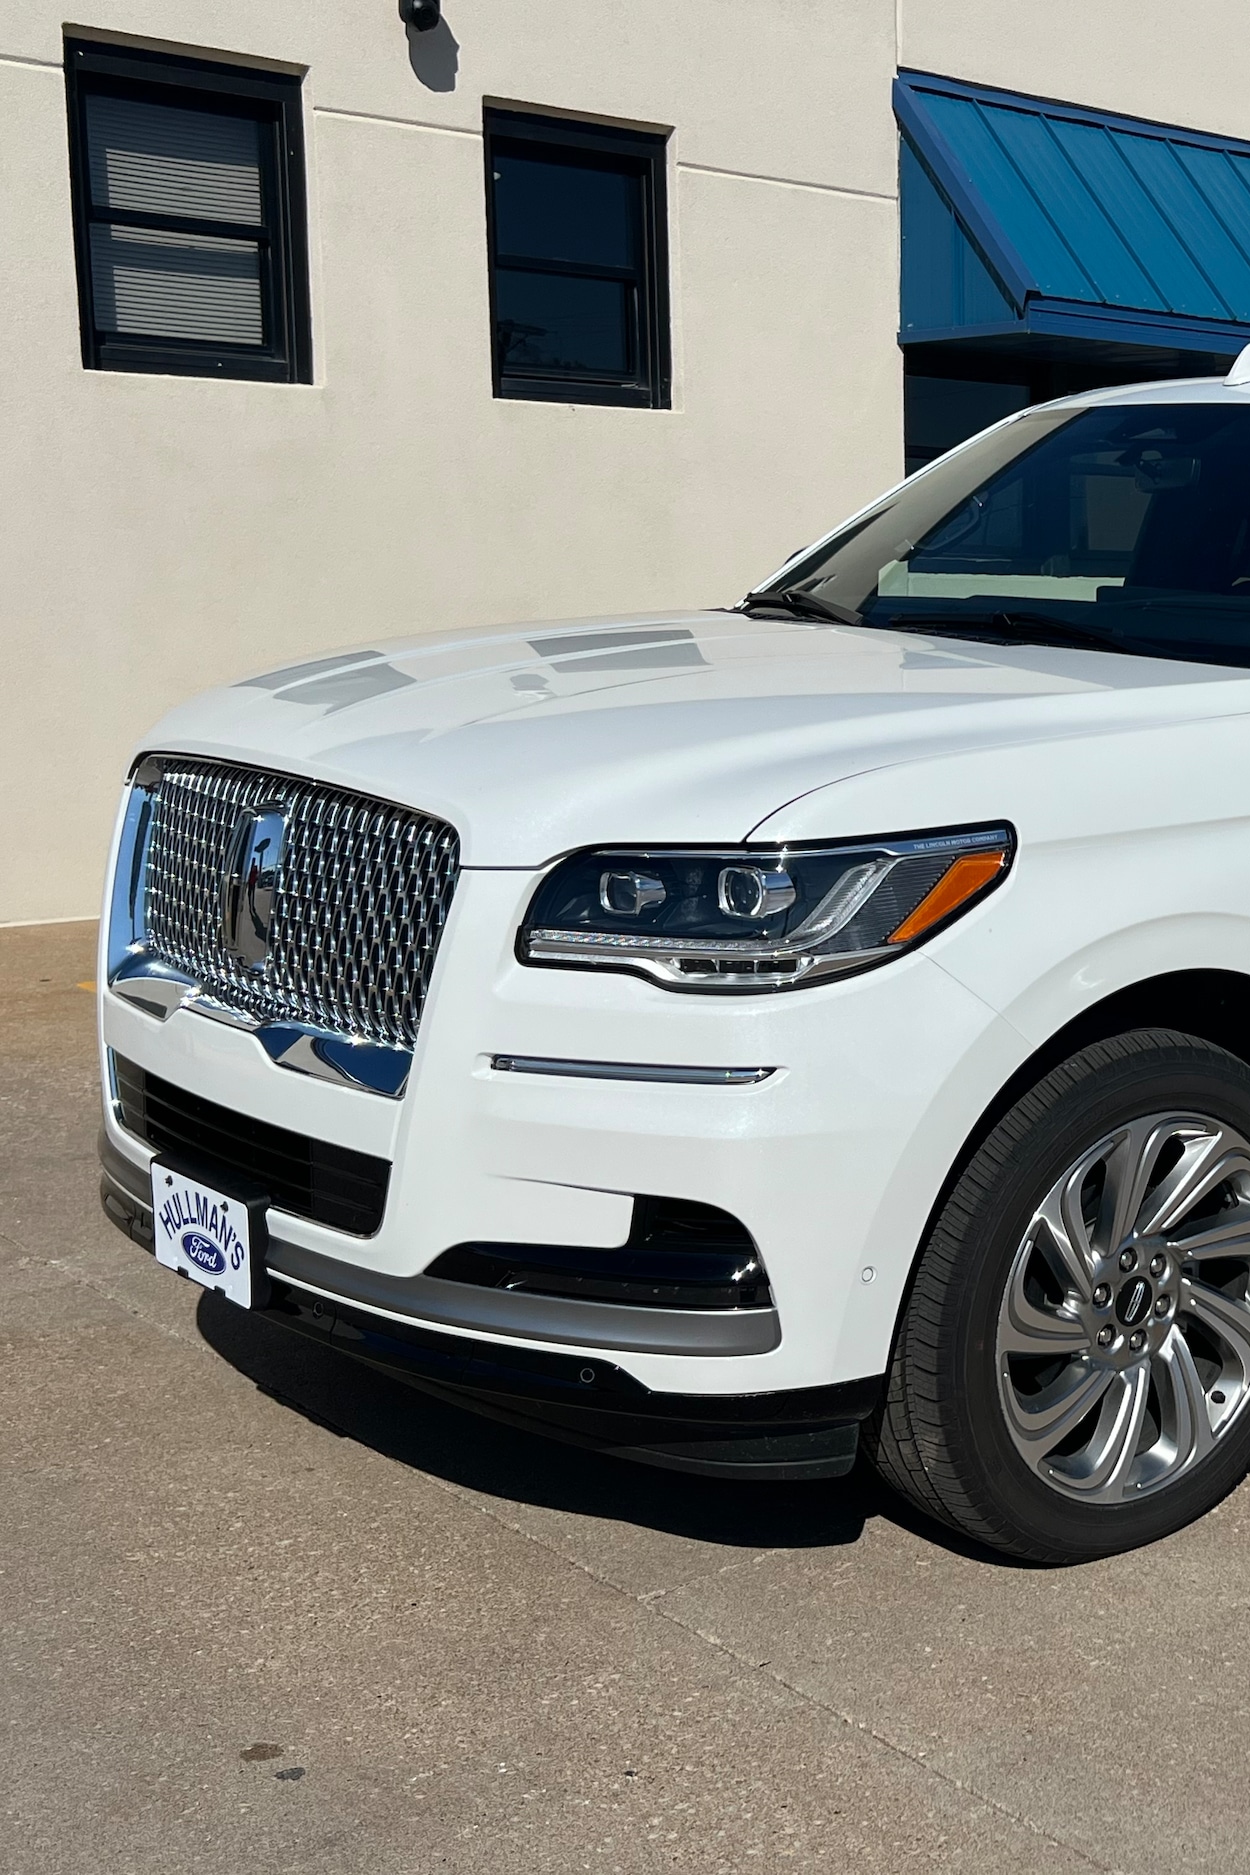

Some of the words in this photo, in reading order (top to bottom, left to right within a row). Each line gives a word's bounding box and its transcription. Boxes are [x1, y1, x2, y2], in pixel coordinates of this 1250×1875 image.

[913, 842, 926, 850] THE
[926, 840, 951, 849] LINCOLN
[951, 837, 971, 846] MOTOR
[971, 834, 998, 843] COMPANY
[159, 1190, 245, 1271] HULLMAN'S
[189, 1236, 218, 1269] Ford
